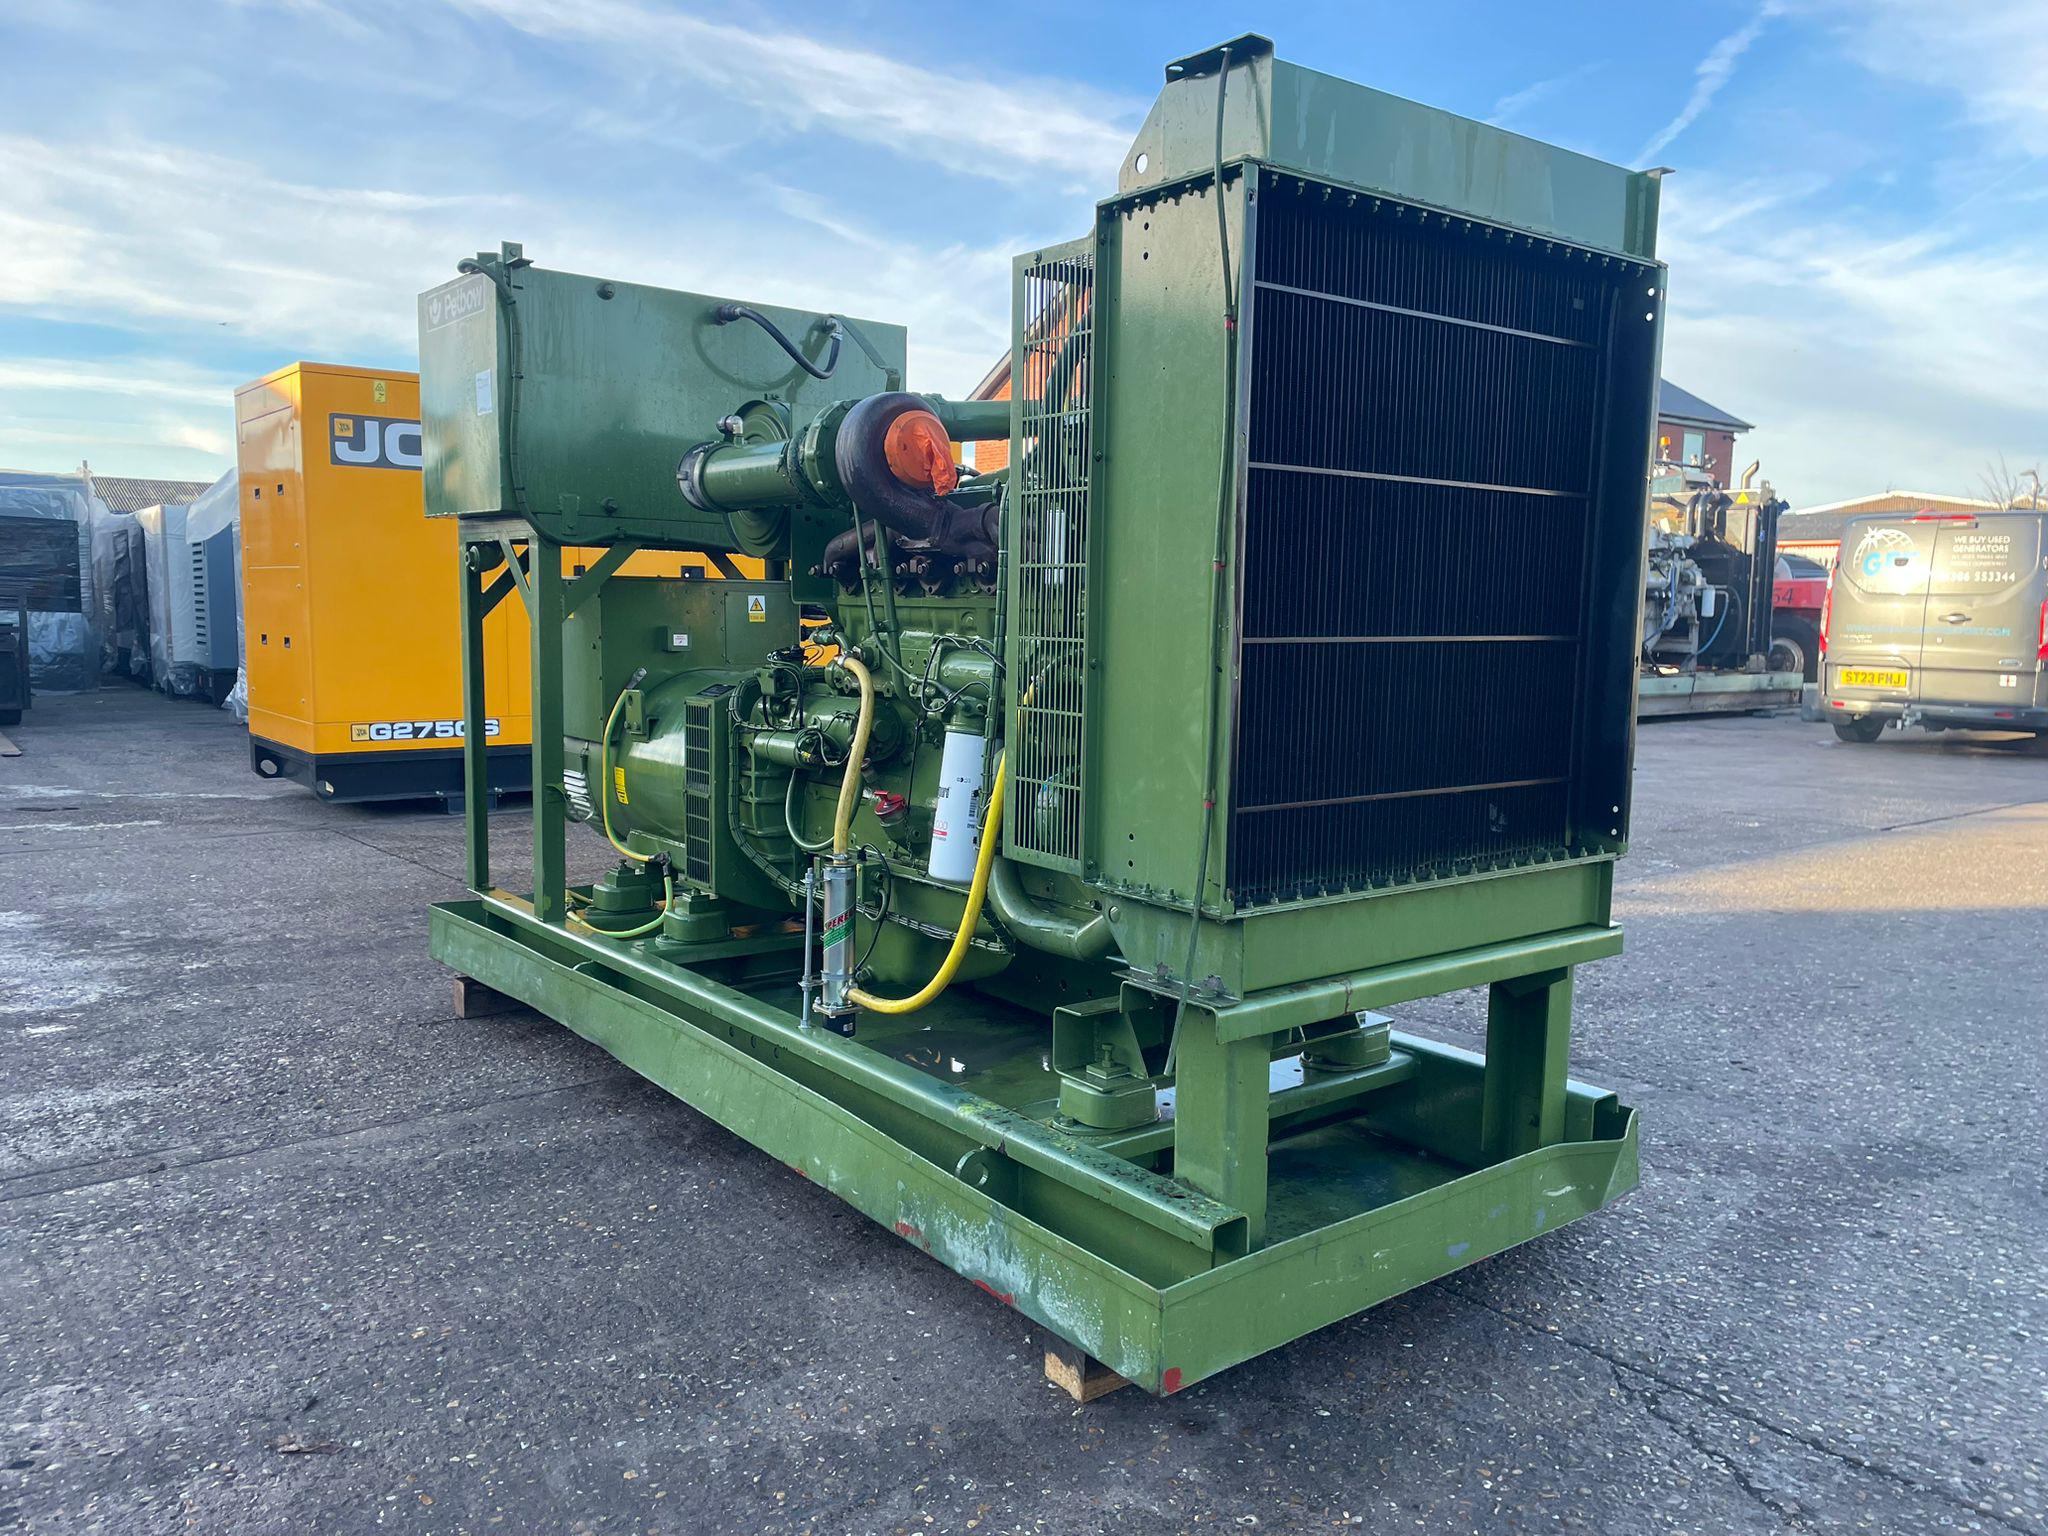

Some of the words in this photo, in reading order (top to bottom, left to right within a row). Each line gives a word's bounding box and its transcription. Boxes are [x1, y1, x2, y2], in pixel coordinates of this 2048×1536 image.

[1954, 535, 1967, 544] WE
[1969, 535, 1987, 544] BUY
[1988, 535, 2011, 544] USED
[1952, 545, 2009, 553] GENERATORS
[1846, 671, 1875, 684] ST23
